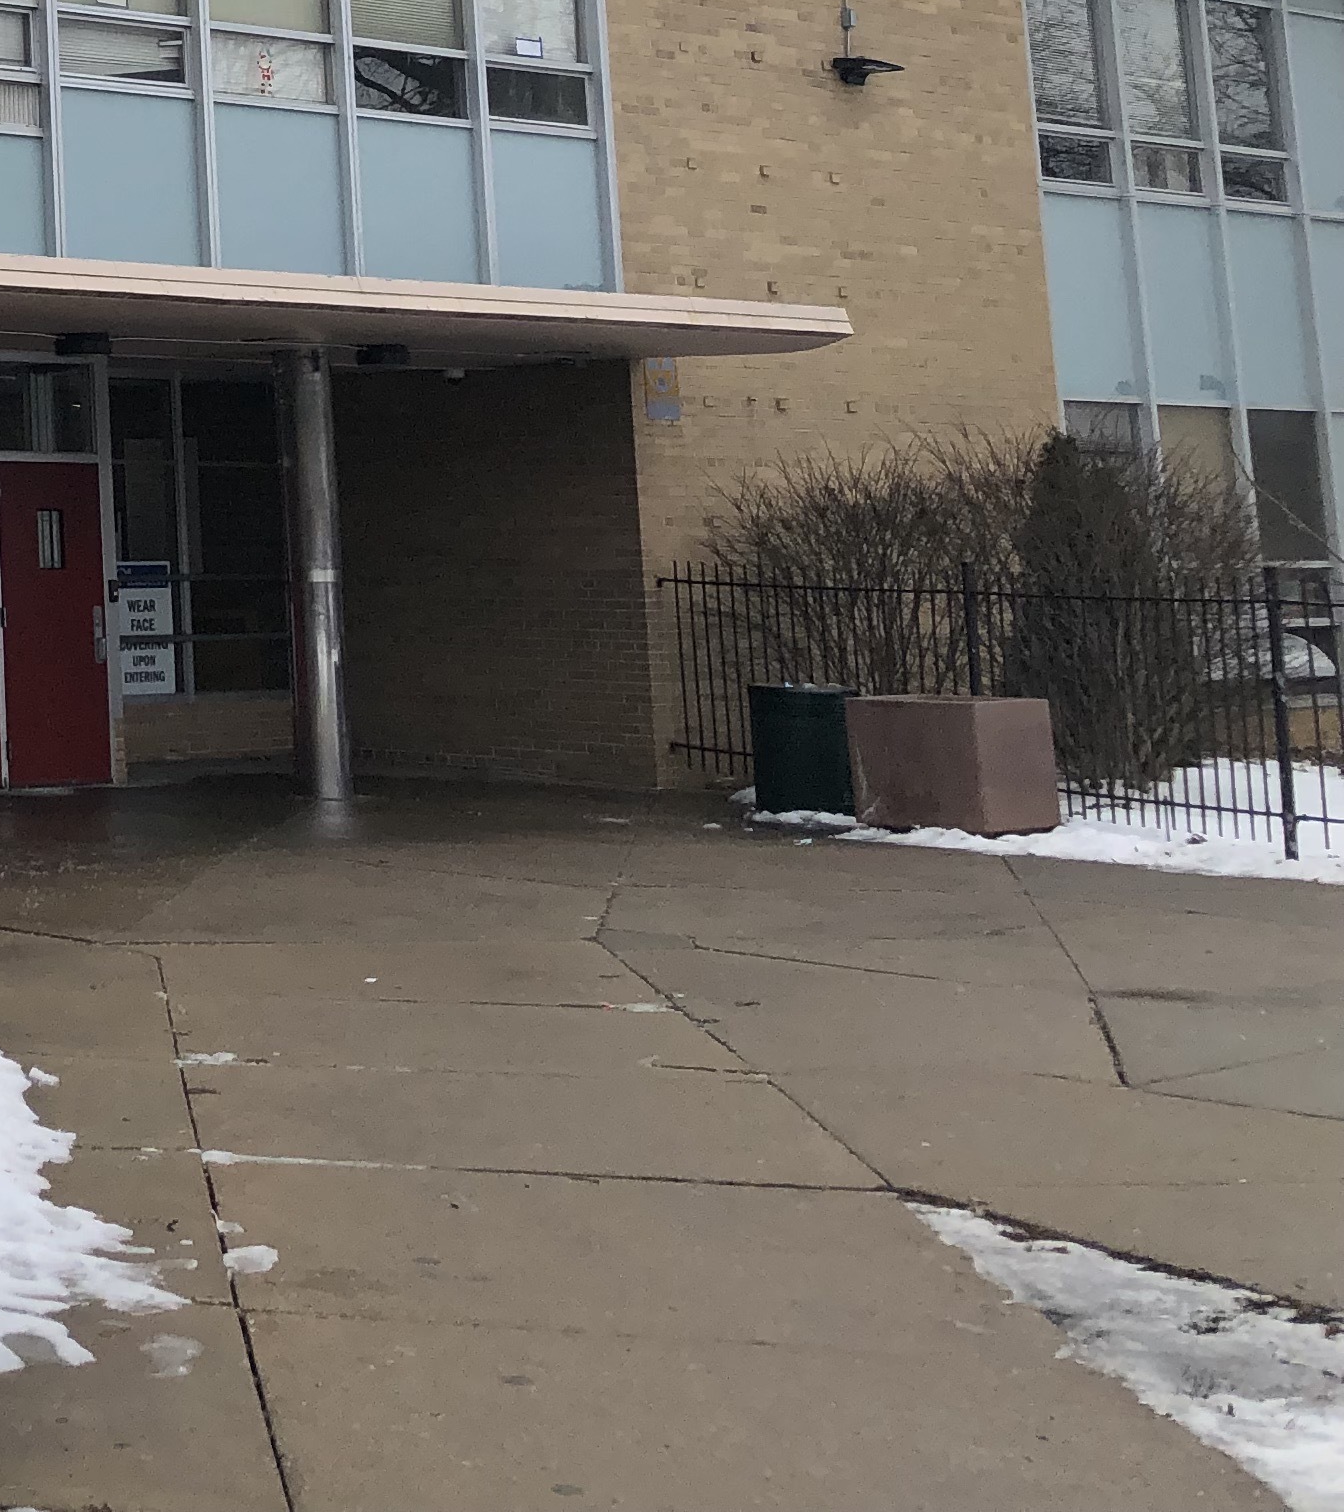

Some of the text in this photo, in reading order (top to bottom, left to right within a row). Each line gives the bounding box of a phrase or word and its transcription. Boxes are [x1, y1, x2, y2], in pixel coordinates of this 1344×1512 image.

[126, 599, 156, 613] WEAR
[130, 618, 156, 632] FACE
[132, 654, 156, 667] UPON
[124, 671, 166, 684] ENTERING
